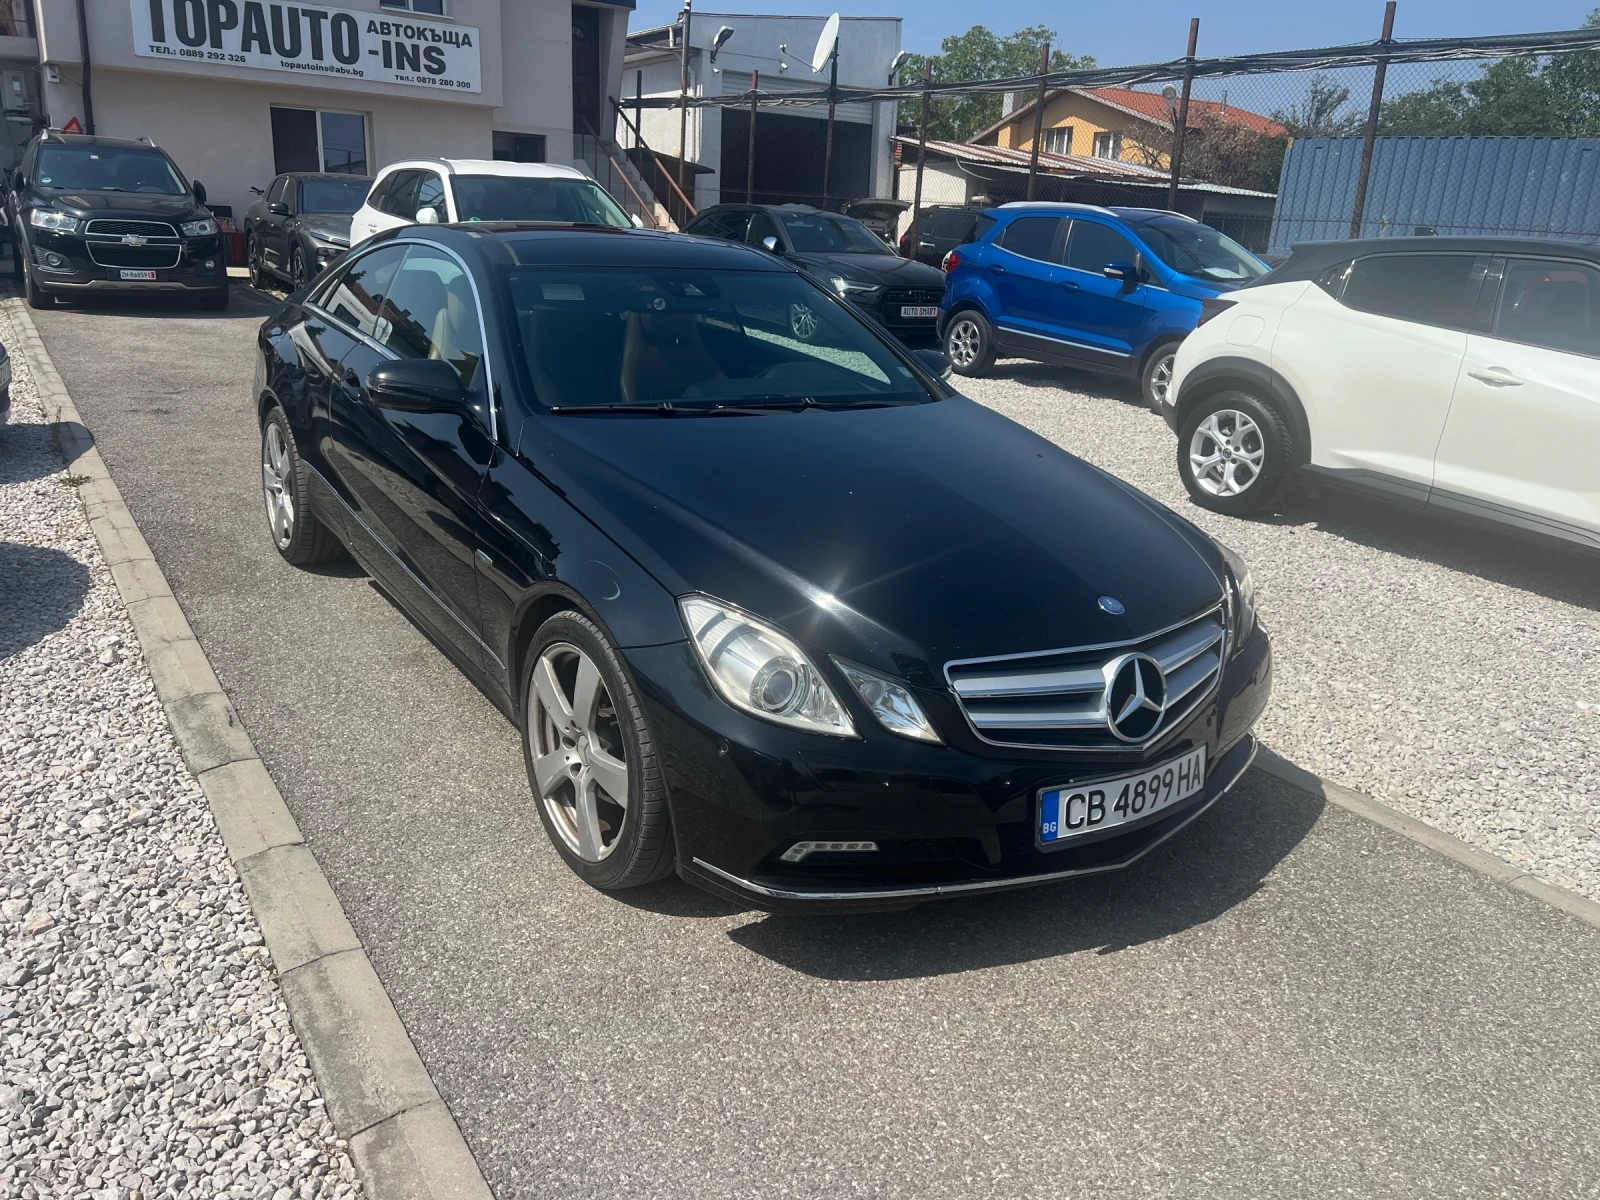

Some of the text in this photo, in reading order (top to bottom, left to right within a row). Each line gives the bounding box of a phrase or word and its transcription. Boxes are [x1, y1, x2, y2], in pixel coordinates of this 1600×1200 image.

[366, 19, 473, 48] АВТОКЪЩА
[179, 48, 204, 58] 0889
[207, 51, 226, 60] 292
[228, 53, 247, 63] 326
[280, 60, 364, 77] topautoins@abv.bg
[416, 76, 437, 85] 0878
[439, 79, 454, 87] 280
[456, 80, 471, 89] 300
[903, 307, 936, 316] AUTO SMART
[1112, 767, 1174, 818] 4899
[1042, 821, 1057, 834] BG
